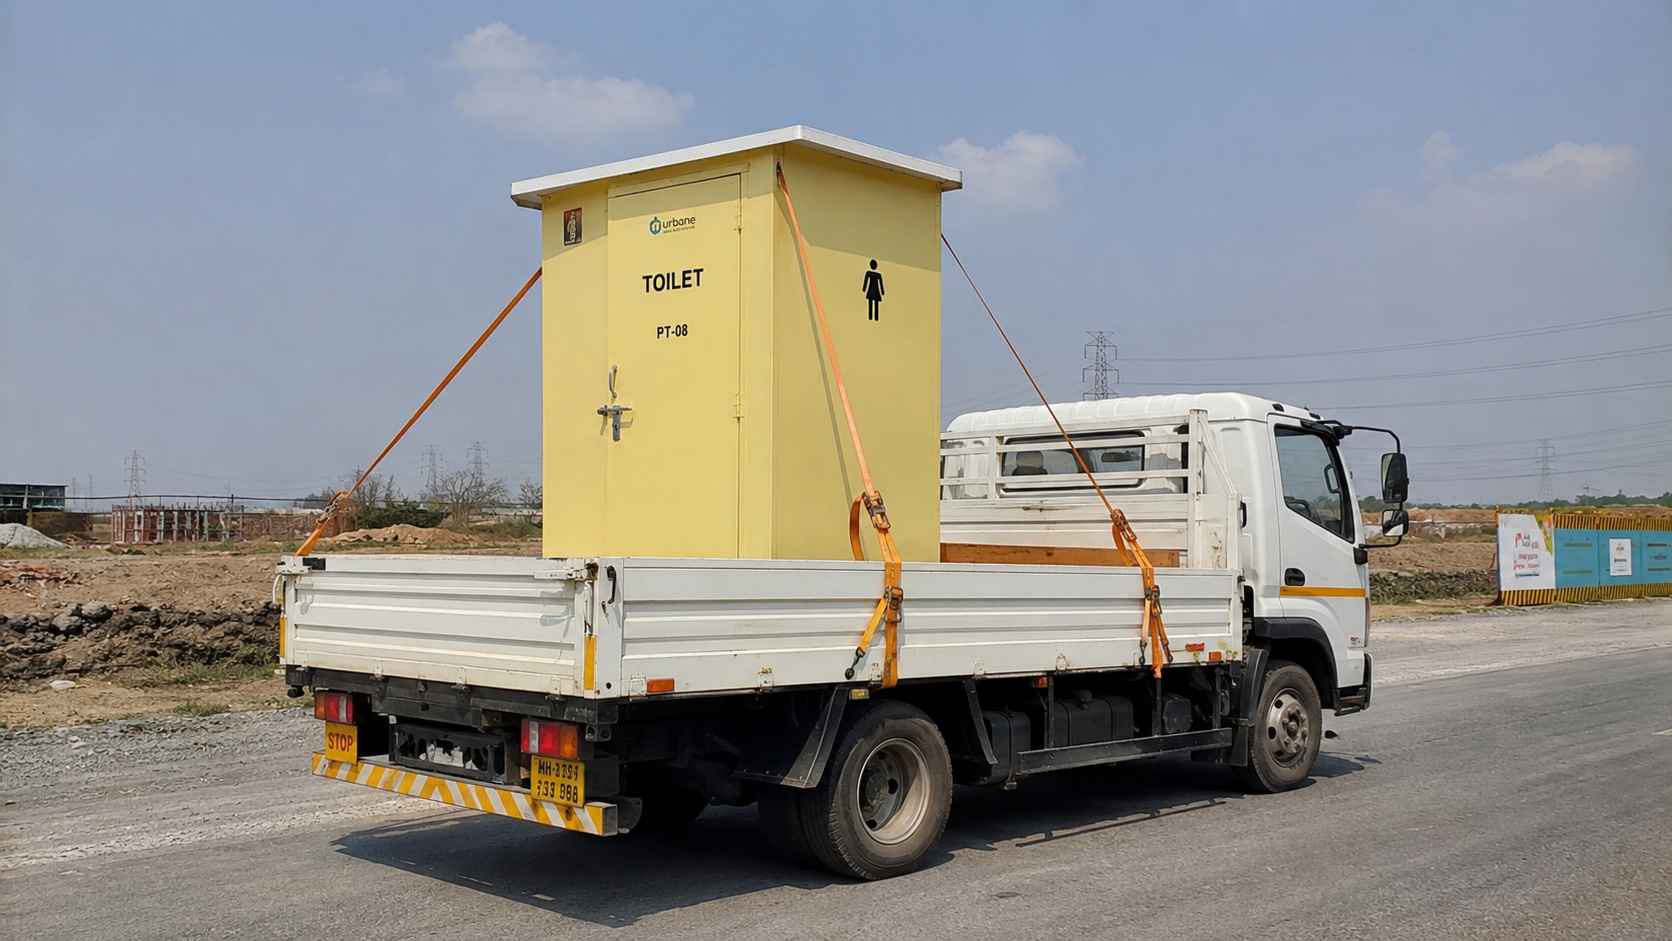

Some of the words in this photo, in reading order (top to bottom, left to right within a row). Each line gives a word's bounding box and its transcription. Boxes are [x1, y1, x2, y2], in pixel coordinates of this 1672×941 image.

[663, 216, 696, 229] urbane
[642, 268, 704, 293] TOILET
[657, 324, 688, 339] PT-08
[328, 732, 353, 752] STOP
